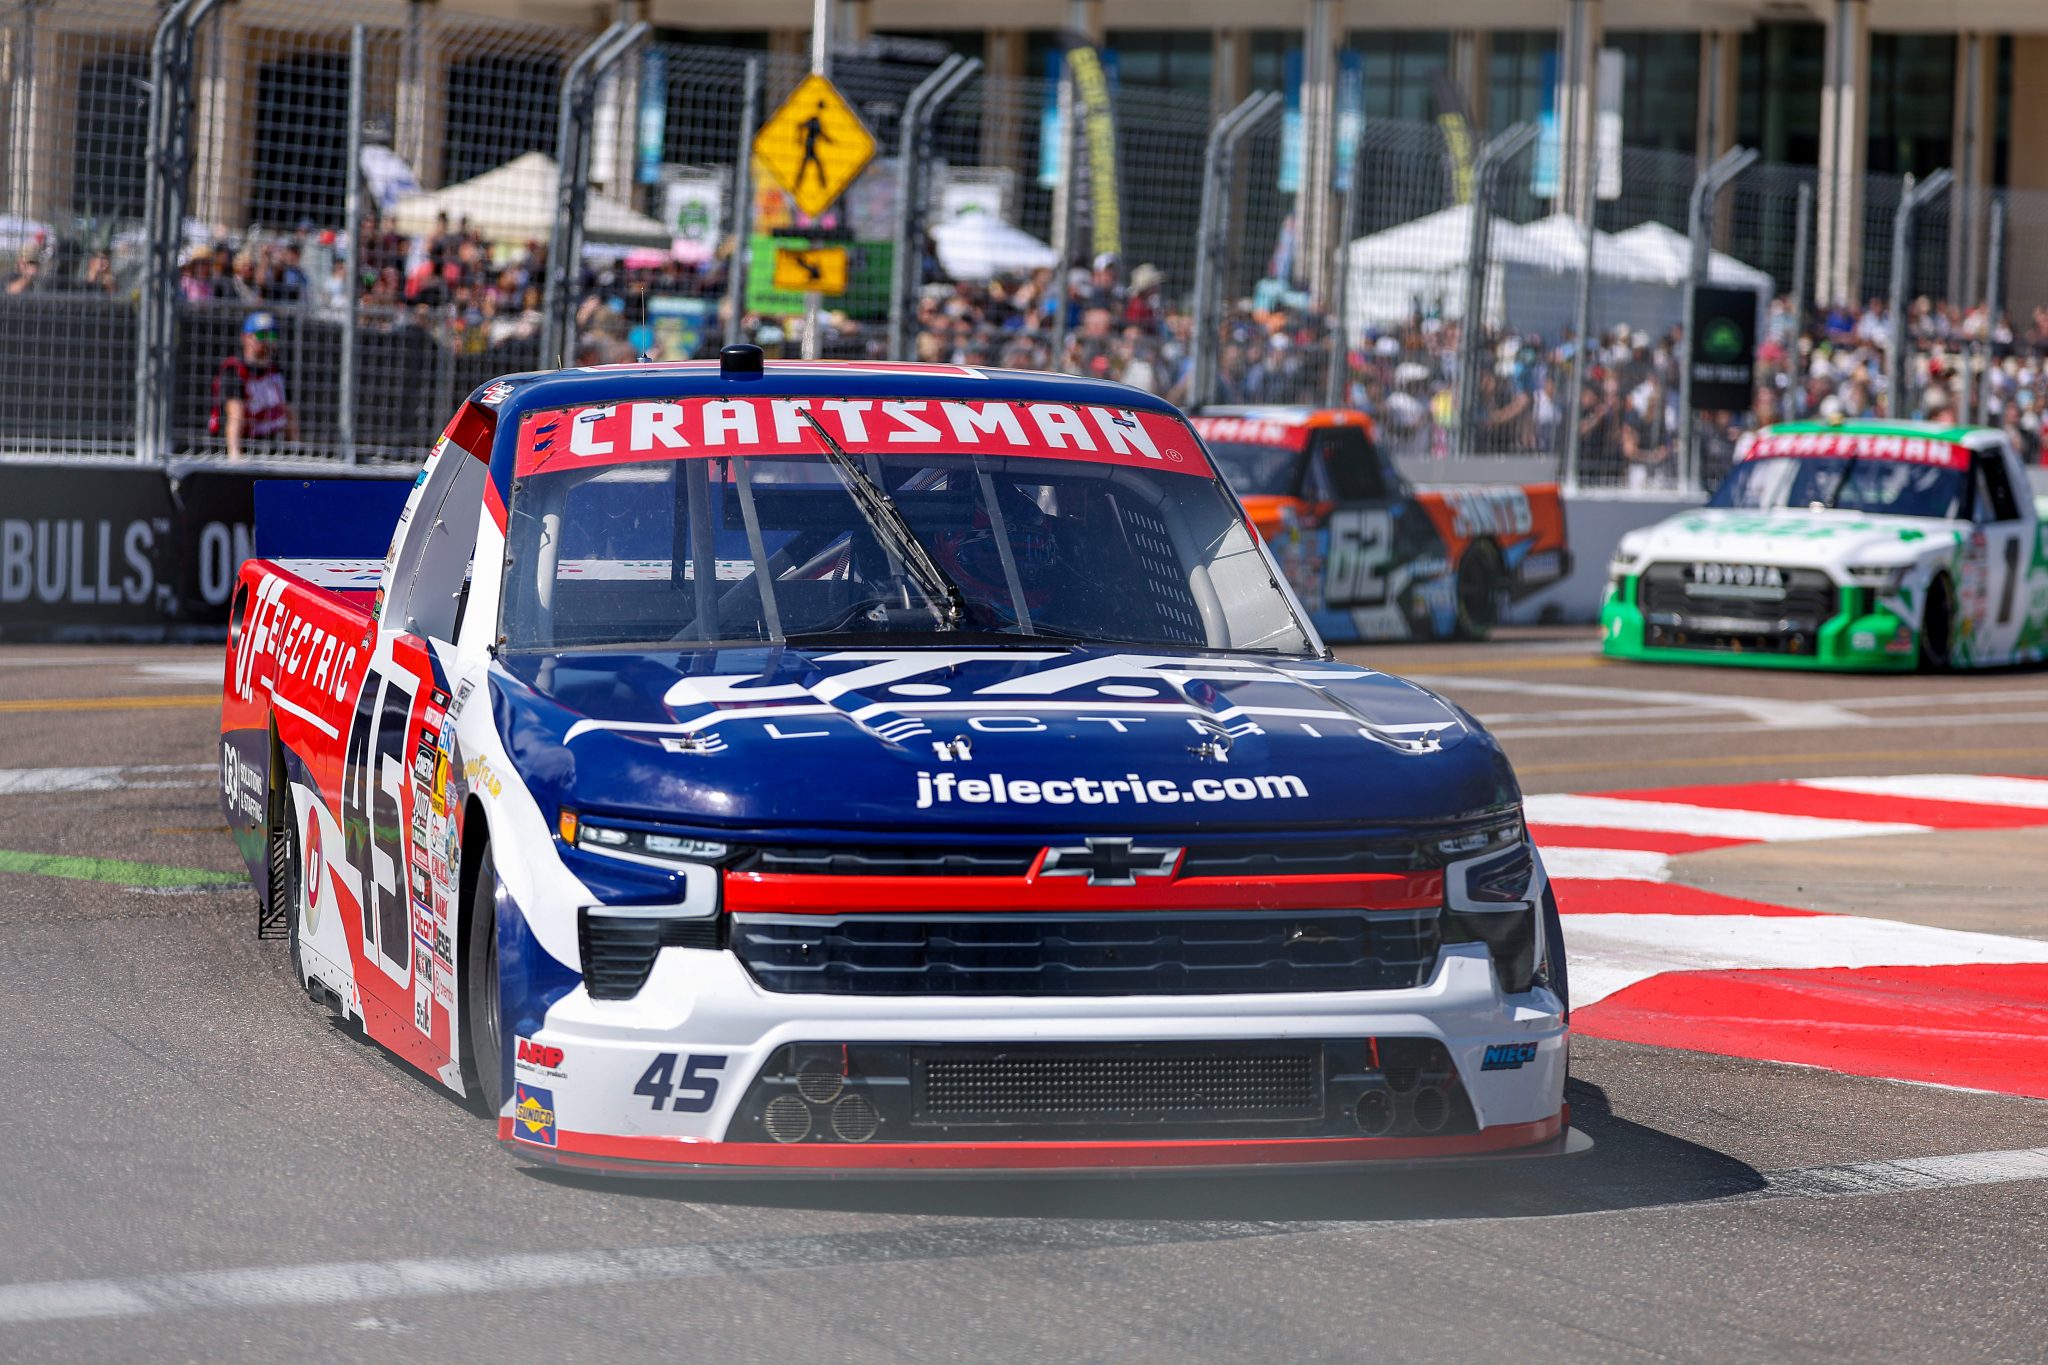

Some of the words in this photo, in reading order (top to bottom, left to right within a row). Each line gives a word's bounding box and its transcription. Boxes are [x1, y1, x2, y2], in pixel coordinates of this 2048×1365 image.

[1327, 510, 1392, 600] 62
[1692, 562, 1784, 588] TOYOTA
[267, 601, 357, 703] ELECTRIC
[240, 763, 262, 796] SOLUTIONS
[916, 770, 1309, 809] jfelectric.com
[243, 794, 263, 824] STAFFING
[344, 668, 412, 971] 45
[517, 1039, 564, 1069] ARP
[633, 1052, 729, 1113] 45
[517, 1105, 552, 1126] SUNOCO
